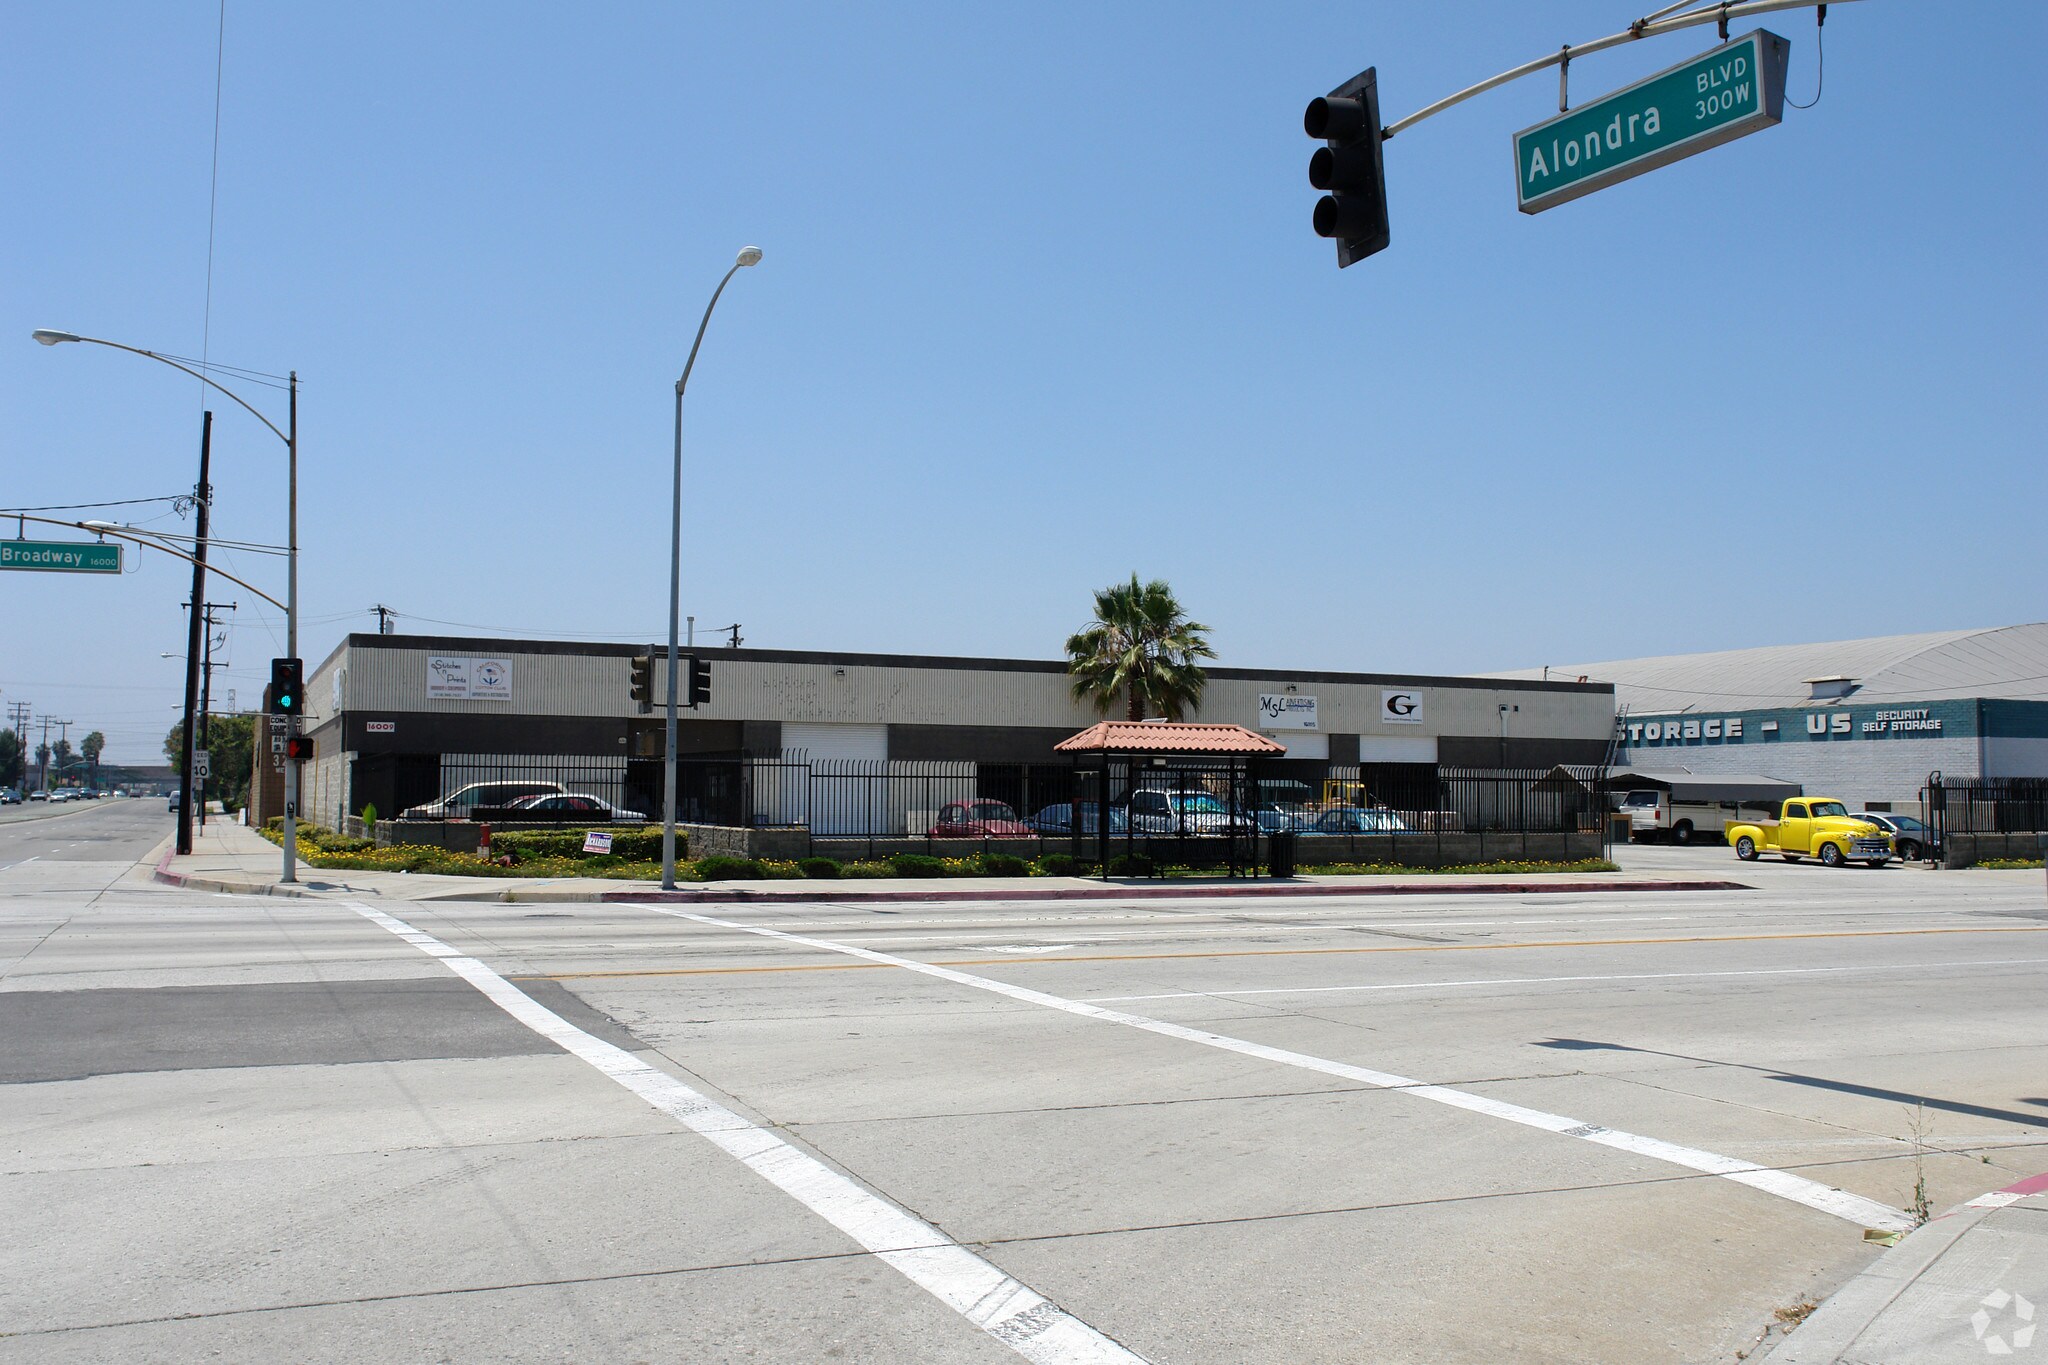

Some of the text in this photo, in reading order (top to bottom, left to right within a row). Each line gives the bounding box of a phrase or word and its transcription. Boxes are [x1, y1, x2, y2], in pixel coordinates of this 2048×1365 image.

[1696, 57, 1747, 93] BLVD
[1695, 81, 1750, 120] 300W
[1528, 106, 1661, 183] Alondra
[2, 547, 117, 566] Broadway 16000
[435, 659, 461, 670] Stitches
[446, 673, 467, 683] Prints
[1387, 694, 1418, 716] G
[1876, 709, 1929, 721] SECURITY
[1806, 713, 1852, 734] US
[1862, 719, 1942, 732] SELF STORAGE
